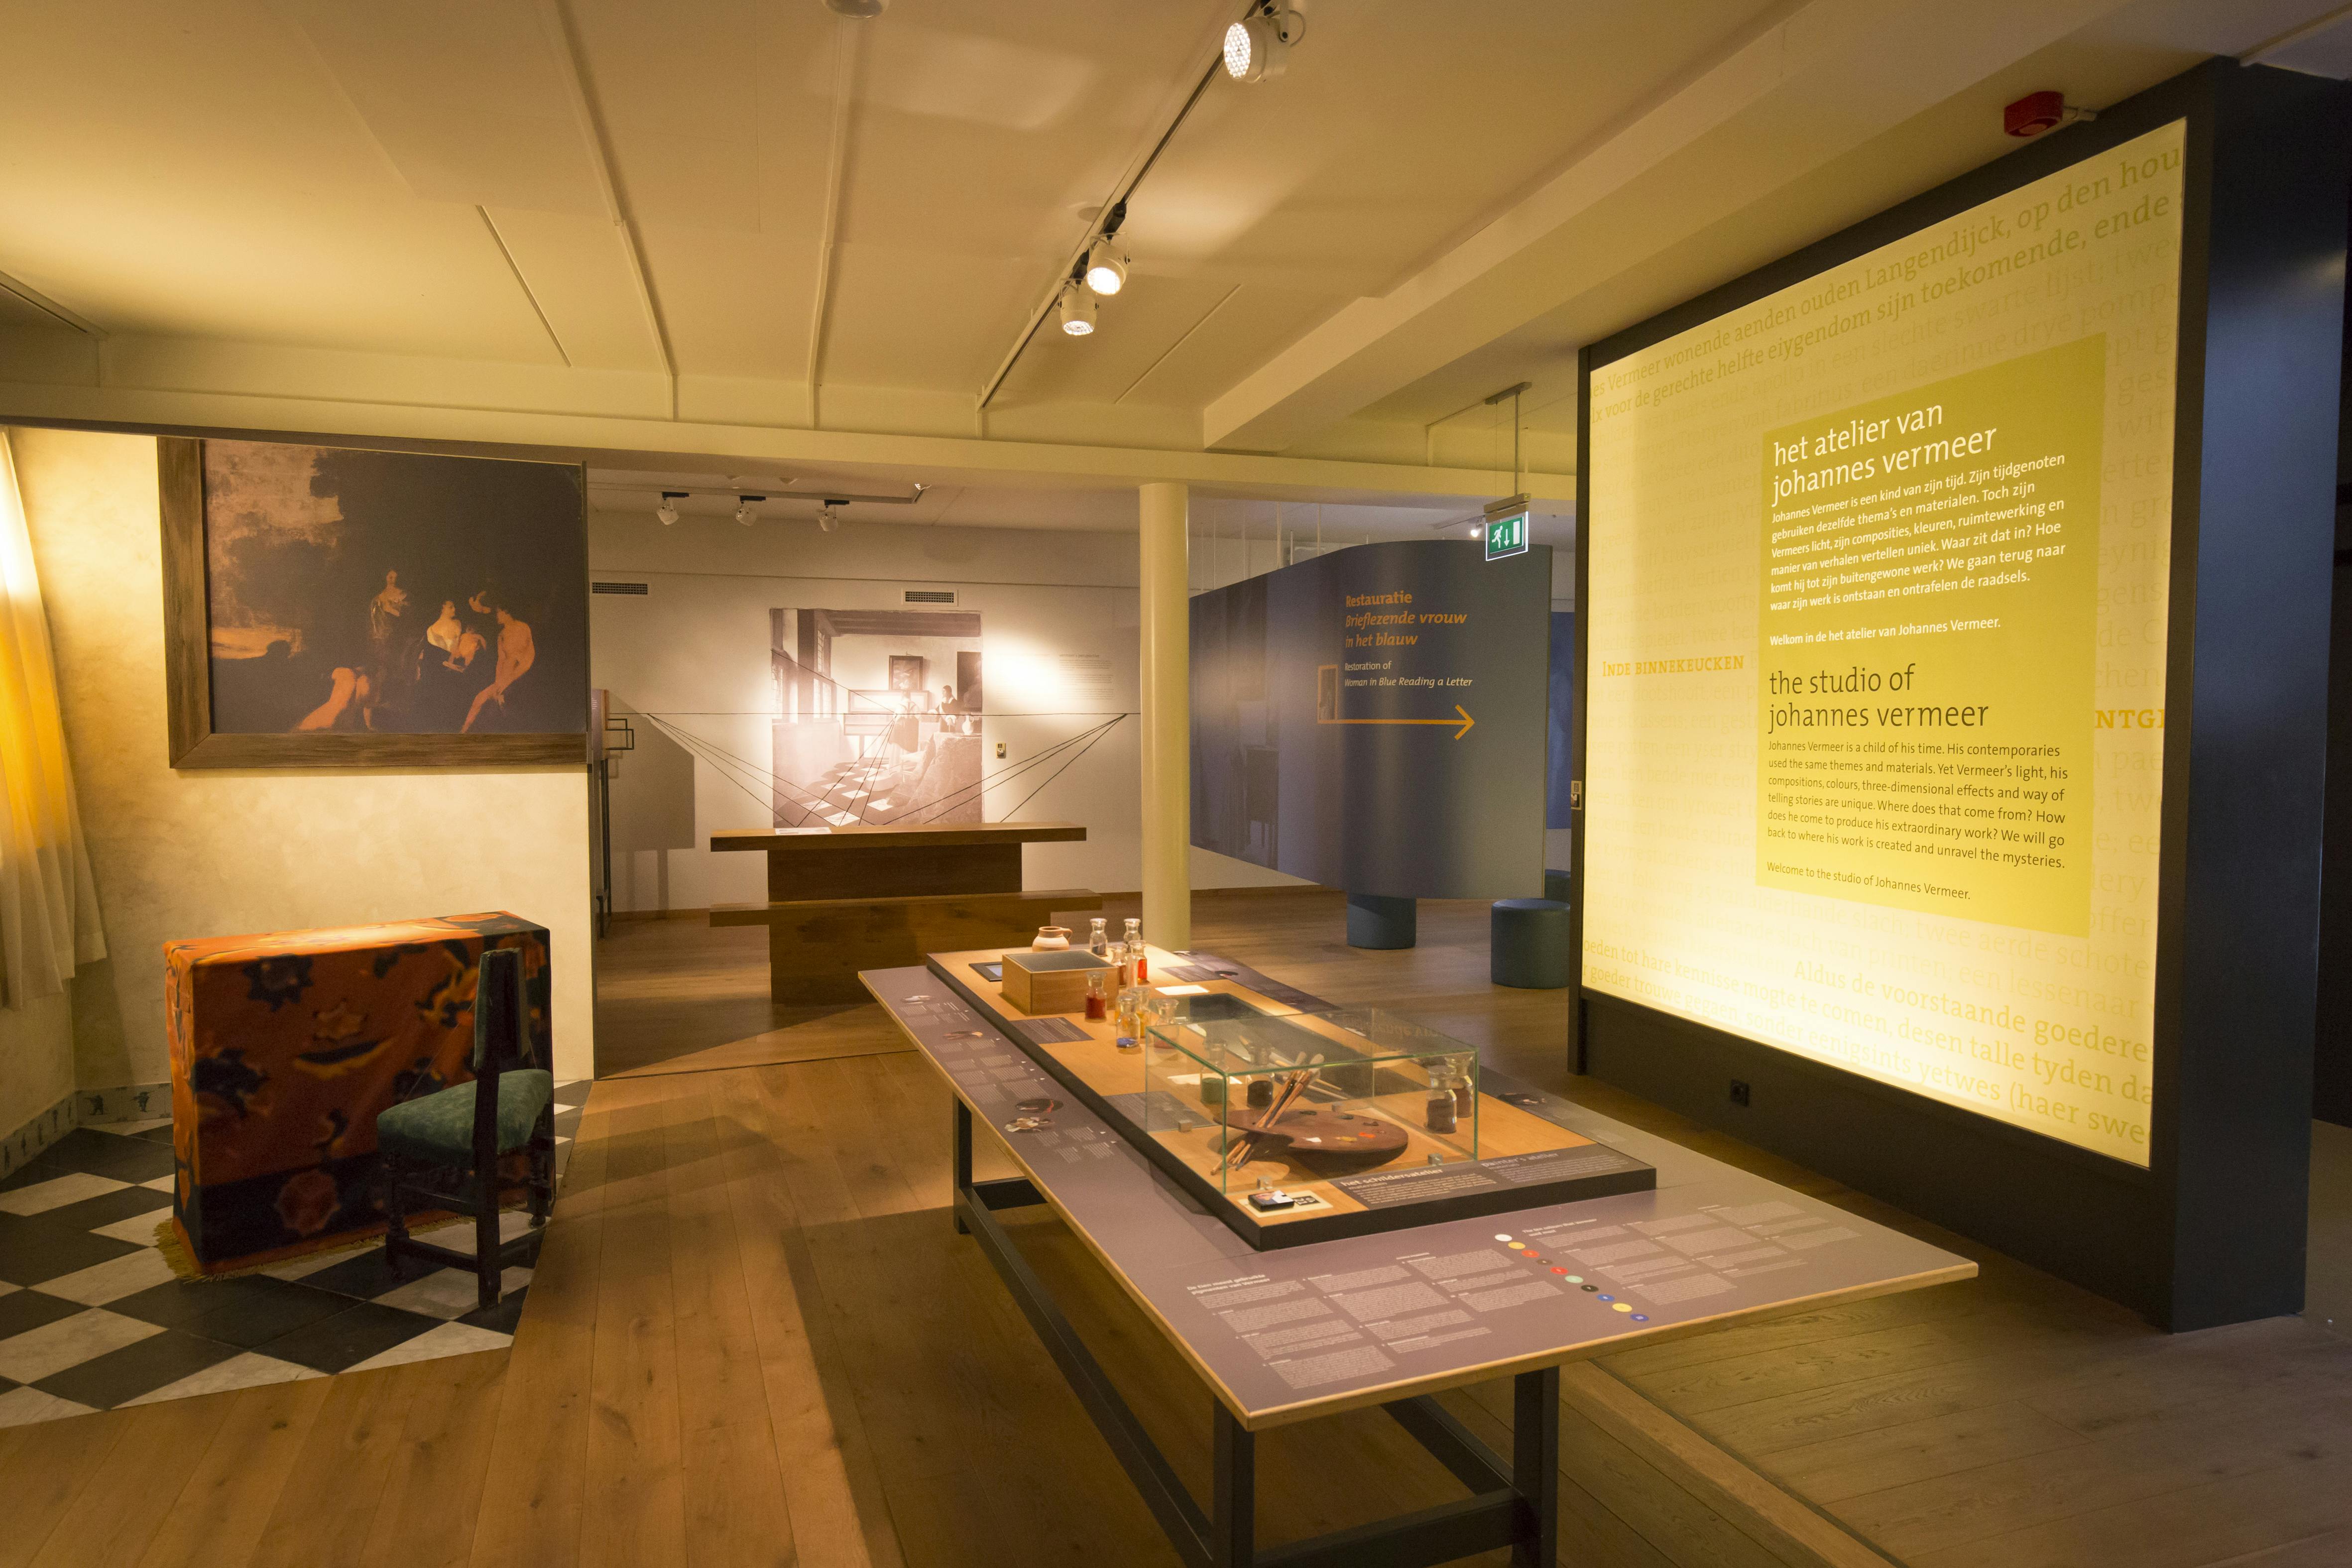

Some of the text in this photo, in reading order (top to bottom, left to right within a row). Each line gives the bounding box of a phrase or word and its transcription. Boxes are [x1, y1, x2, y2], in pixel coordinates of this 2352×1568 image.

[1607, 360, 1660, 391] Vermeer
[1663, 329, 1729, 369] wonende
[1734, 305, 1794, 342] aenden
[1800, 279, 1861, 315] ouden
[1865, 214, 2010, 290] Langendijck,
[2017, 201, 2050, 232] op
[2057, 176, 2110, 213] den
[1773, 404, 1943, 467] het atelier van
[1771, 427, 1998, 507] johannes vermeer
[1771, 454, 2065, 523] Johannes Vermeer is een kind van zijn tijd. Zijn tijdgenoten
[1771, 499, 2065, 559] Vermeers licht, zijn composities, kleuren, ruimtewerking en
[1771, 522, 2062, 576] manier van verhalen vertellen uniek. Waar zit dat in? Hoe
[1346, 591, 1412, 607] Restauratie
[1769, 569, 2031, 611] waar zijn werk is ontstaan en ontrafelen de raadsels.
[1346, 610, 1467, 629] Brieflezende vrouw
[1769, 617, 2001, 646] Welkom in de het atelier van Johannes Vermeer.
[1346, 633, 1418, 648] in het blauw
[1383, 661, 1392, 670] of
[1602, 655, 1744, 677] INDE BINNEKEUCKEN
[1768, 662, 1916, 695] the studio of
[1345, 678, 1368, 686] Woman
[1379, 677, 1396, 686] Blue
[1399, 677, 1434, 688] Reading
[1446, 677, 1473, 686] Letter
[1767, 702, 1989, 735] johannes vermeer
[1768, 740, 2061, 760] Johannes Vermeer is a child of his time. His contemporaries
[1768, 758, 1787, 768] used
[1789, 758, 1803, 769] the
[1804, 761, 1828, 770] same
[1829, 759, 1864, 772] themes
[1865, 760, 1883, 772] and
[1885, 762, 1936, 774] materials.
[1937, 763, 1954, 775] Yet
[2015, 764, 2047, 782] light,
[2050, 765, 2069, 780] his
[1768, 776, 2066, 805] compositions, colours, three-dimensional effects and way of
[1767, 792, 2066, 824] telling stories are unique. Where does that come from? How
[1767, 827, 2065, 869] back to where his work is created and unravel the mysteries.
[1766, 861, 1971, 900] Welcome to the studio of Johannes Vermeer.
[1793, 960, 2026, 1033] Aldus de voorstaande
